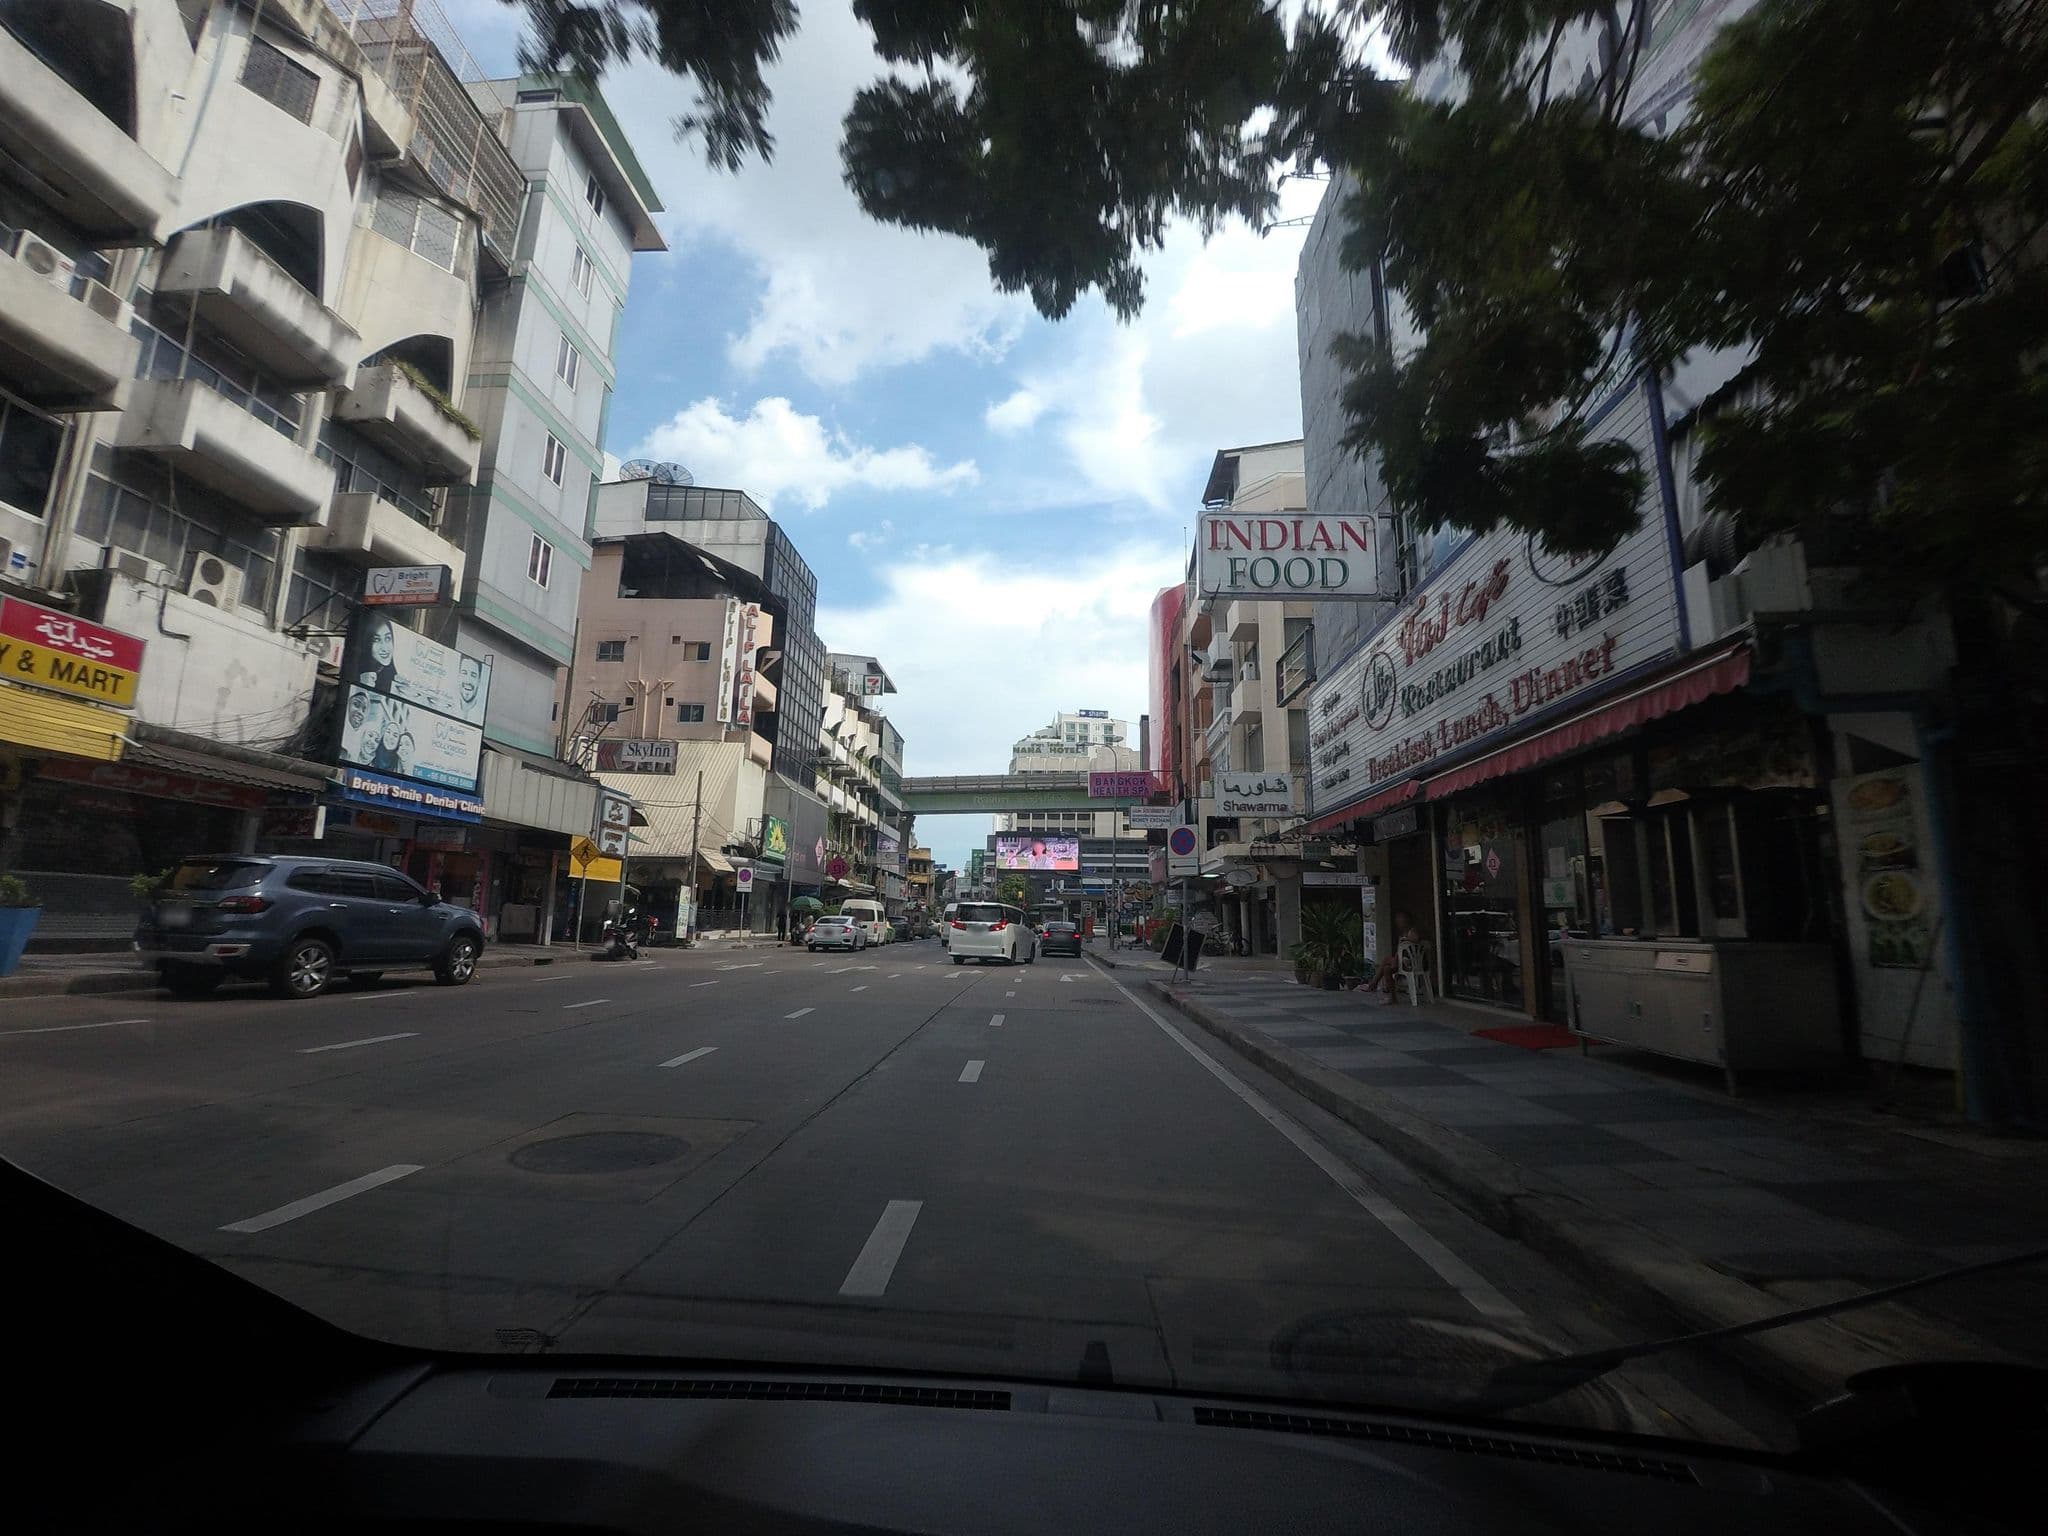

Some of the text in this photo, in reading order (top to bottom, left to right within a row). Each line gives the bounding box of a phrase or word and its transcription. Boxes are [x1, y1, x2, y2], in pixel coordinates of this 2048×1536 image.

[1208, 520, 1369, 552] INDIAN
[398, 572, 429, 581] Bright
[1227, 556, 1350, 590] FOOD
[1397, 592, 1451, 668] Taj
[17, 649, 35, 674] &
[49, 657, 125, 695] MART
[737, 604, 759, 723] ALIF LAILA
[1401, 616, 1522, 719] Restaurant
[1509, 635, 1617, 716] Dinner
[1013, 746, 1082, 754] NANA HOTEL
[352, 777, 487, 815] Bright Smile Dental Clinic
[1095, 777, 1147, 786] BANGKOK
[1222, 777, 1288, 797] شاورما
[1223, 800, 1289, 812] Shawarma
